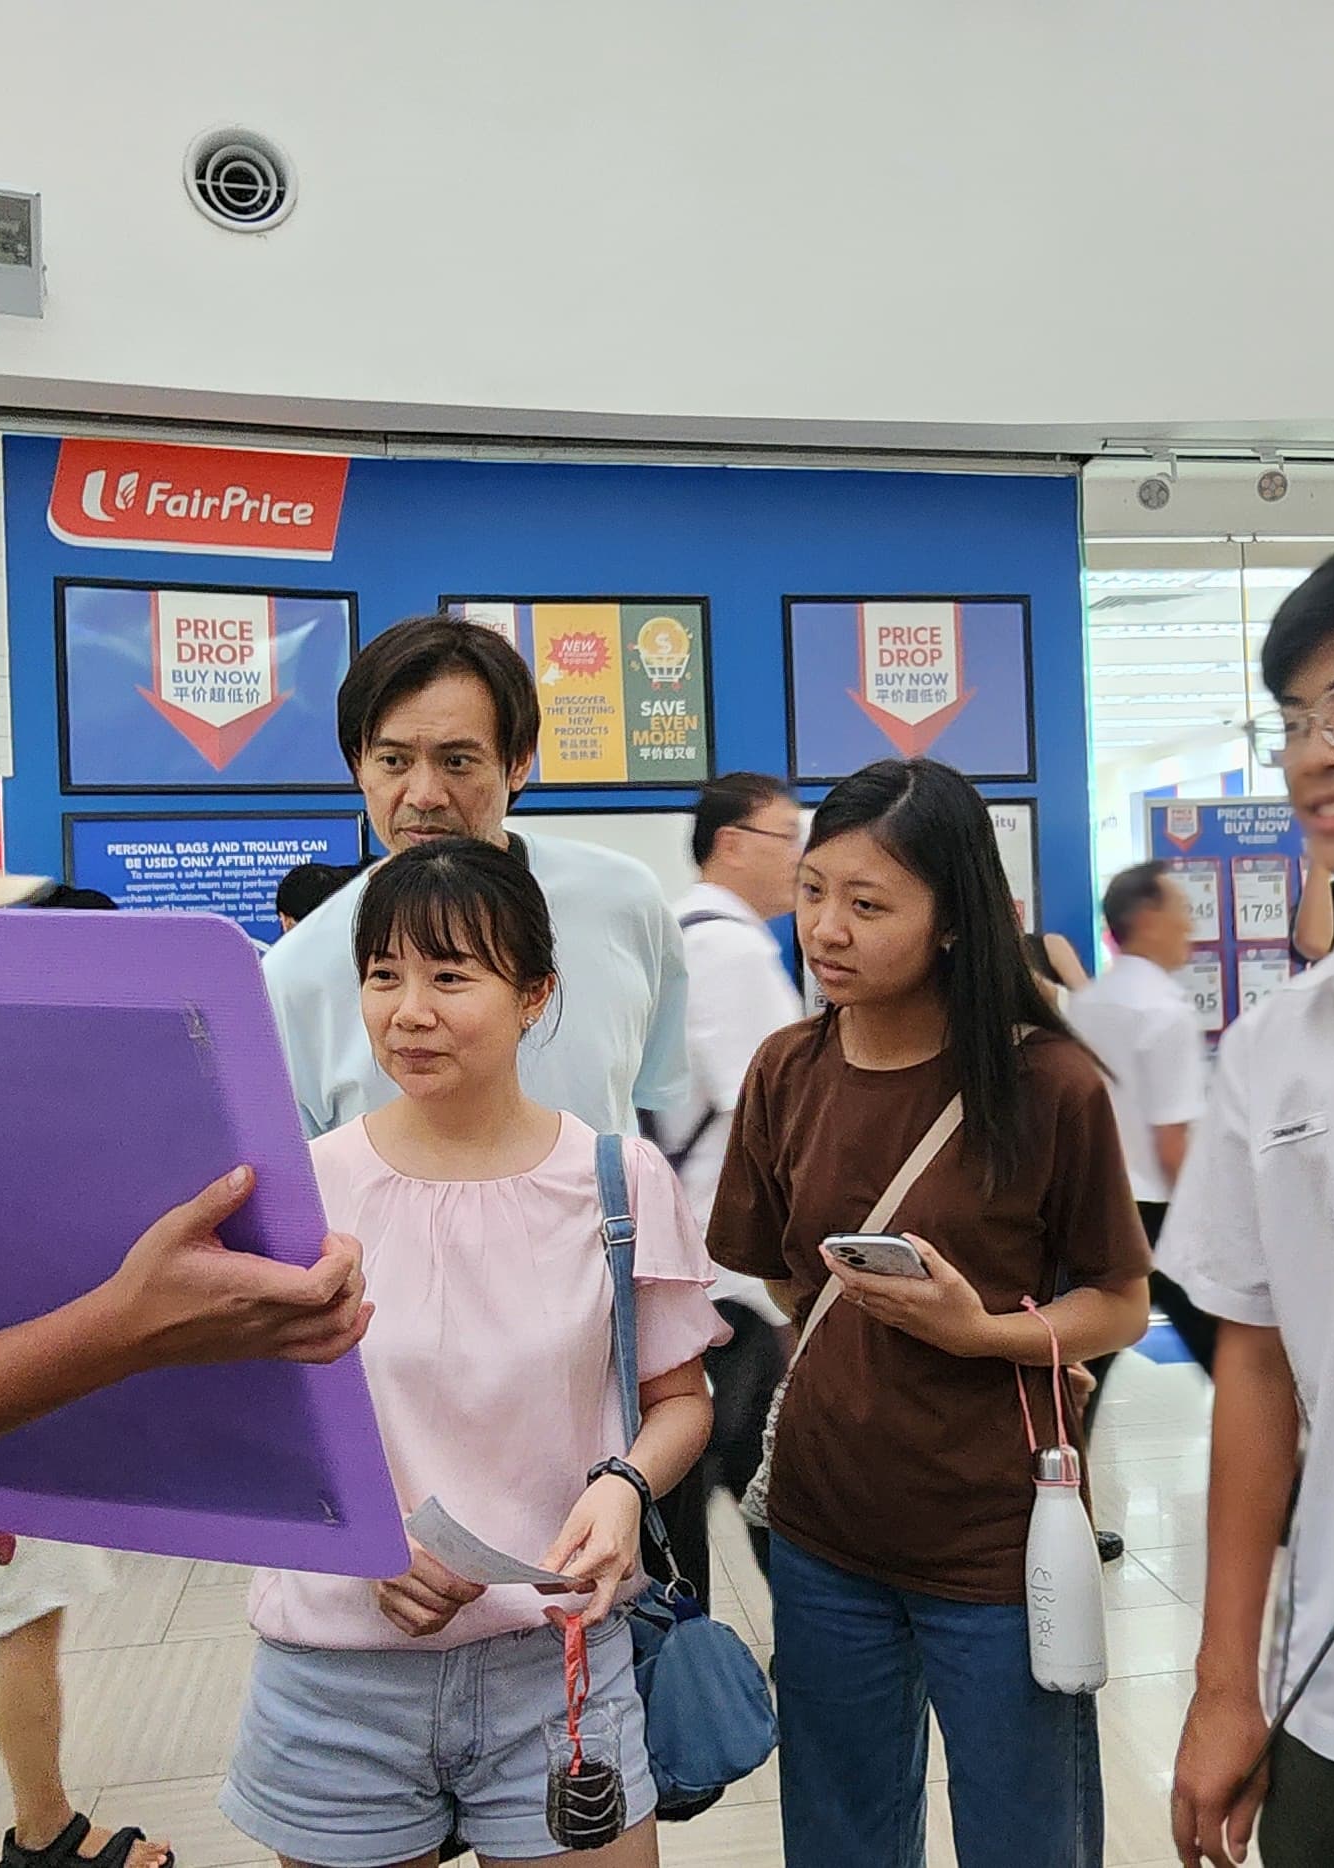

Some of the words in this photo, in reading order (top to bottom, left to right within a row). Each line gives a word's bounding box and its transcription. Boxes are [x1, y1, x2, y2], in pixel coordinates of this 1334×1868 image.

[145, 481, 314, 526] FairPrice
[176, 618, 253, 641] PRICE
[878, 627, 942, 645] PRICE
[562, 640, 595, 651] NEW
[177, 642, 254, 665] DROP
[879, 649, 942, 667] DROP
[171, 669, 209, 684] BUY
[214, 671, 261, 685] NOW
[875, 673, 905, 686] BUY
[909, 672, 949, 685] NOW
[174, 686, 261, 704] 平价超低价
[554, 696, 606, 705] DISCOVER
[877, 689, 948, 703] 平价超低价
[546, 707, 563, 715] THE
[568, 706, 614, 714] EXCITING
[641, 701, 686, 716] SAVE
[650, 716, 698, 730] EVEN
[554, 727, 608, 735] PRODUCTS
[633, 731, 687, 746] MORE
[1218, 808, 1254, 819] PRICE
[1258, 807, 1293, 818] DROP
[1224, 822, 1251, 834] BUY
[1255, 820, 1290, 832] NOW
[107, 842, 174, 856] PERSONAL
[177, 842, 209, 854] BAGS
[213, 841, 239, 853] AND
[243, 841, 299, 852] TROLLEYS
[302, 840, 327, 851] CAN
[125, 858, 142, 869] BE
[145, 857, 178, 868] USED
[181, 856, 214, 867] ONLY
[217, 855, 254, 866] AFTER
[257, 853, 312, 866] PAYMENT
[131, 871, 142, 879] To
[144, 871, 174, 879] ensure
[185, 869, 203, 878] safe
[205, 868, 222, 877] and
[224, 867, 267, 879] enjoyable
[180, 882, 195, 890] our
[198, 880, 219, 889] team
[222, 881, 241, 891] may
[114, 893, 152, 903] urchase
[212, 891, 240, 900] Please
[239, 902, 253, 911] the
